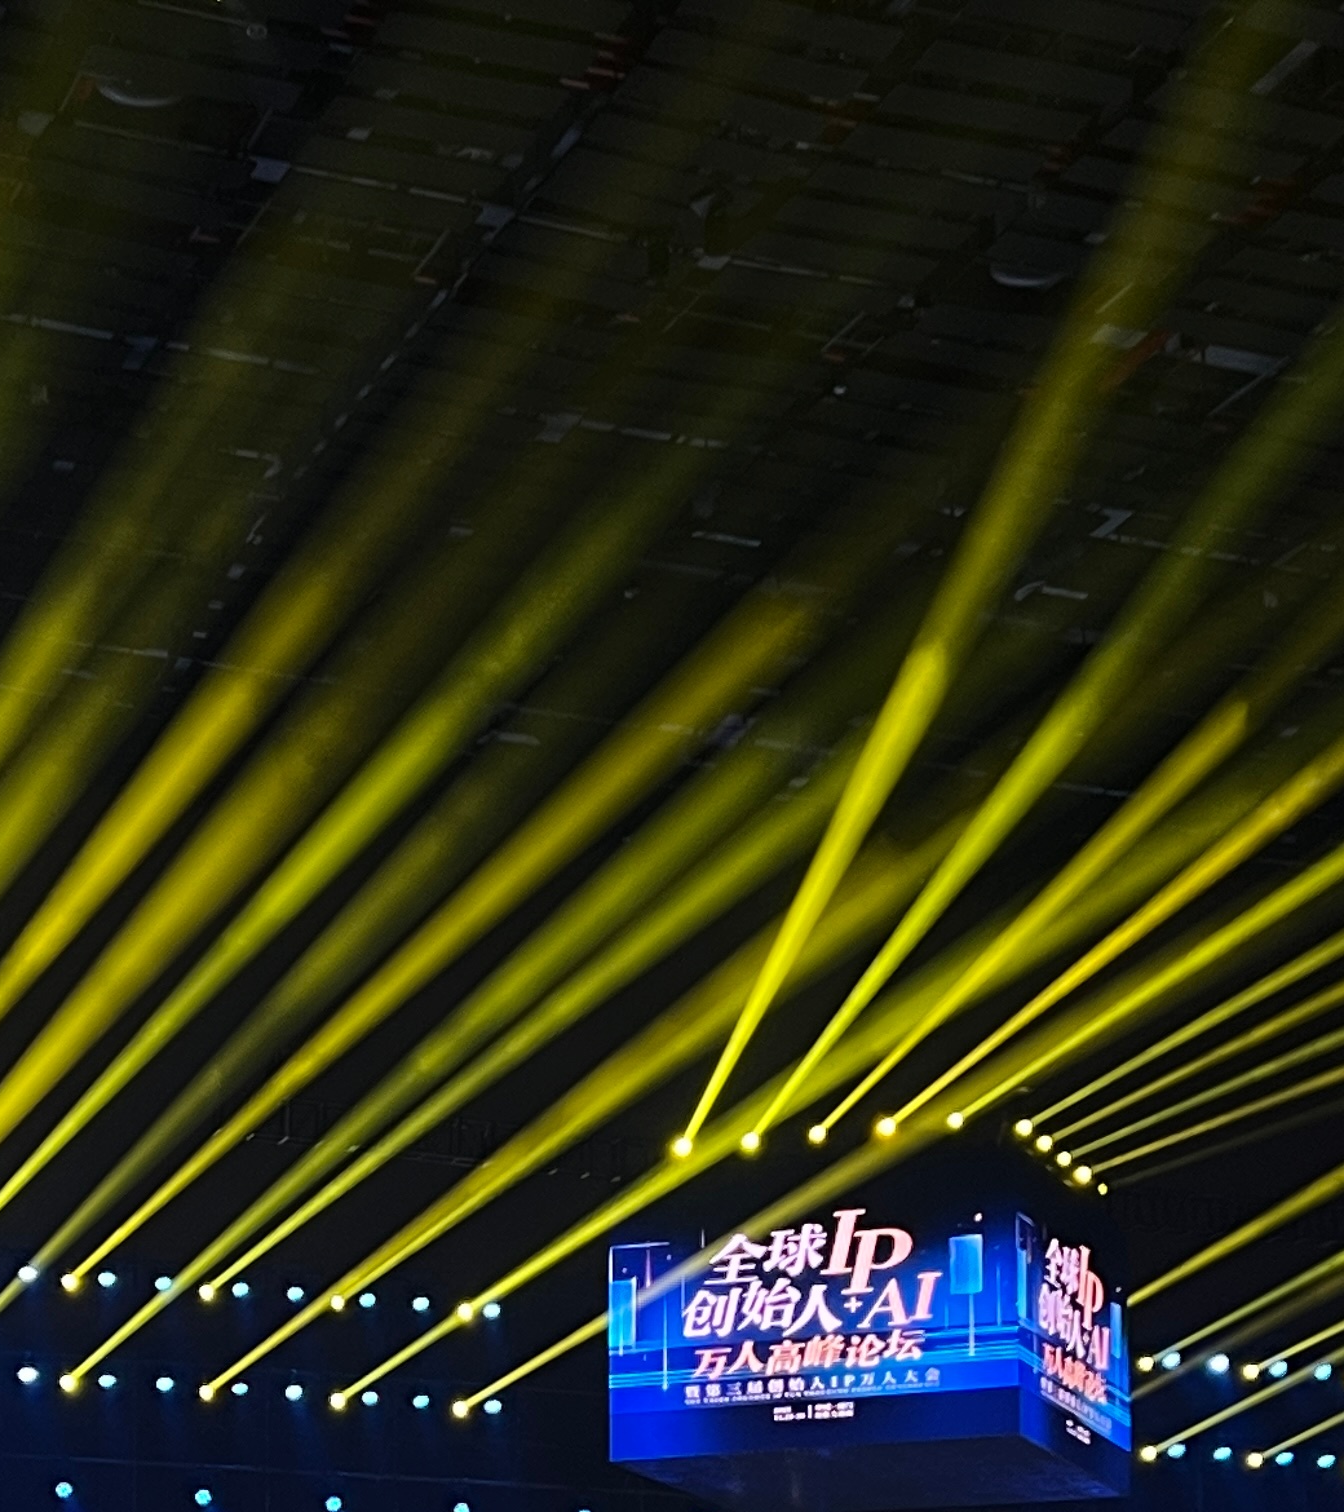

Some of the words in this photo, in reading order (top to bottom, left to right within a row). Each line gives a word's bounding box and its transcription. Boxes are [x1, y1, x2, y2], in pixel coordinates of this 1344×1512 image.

[692, 1328, 926, 1381] 万人高峰论坛
